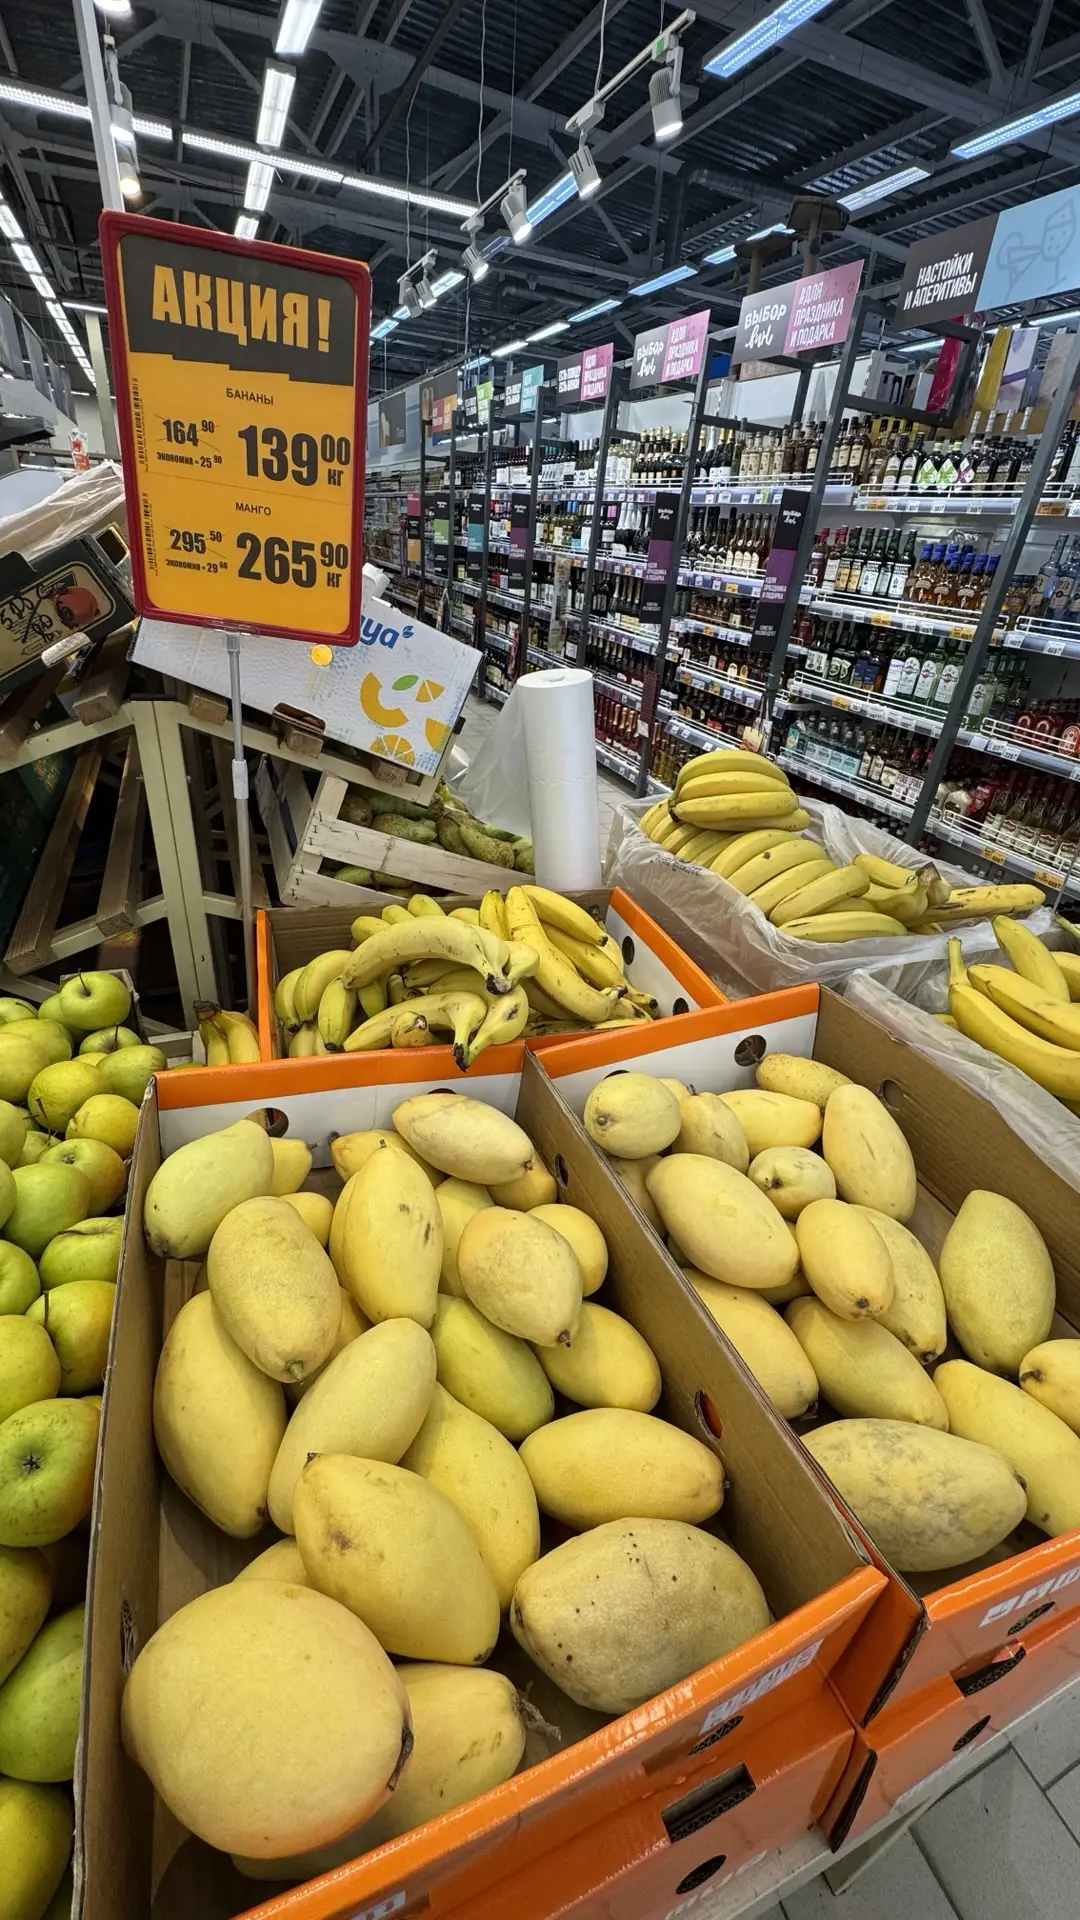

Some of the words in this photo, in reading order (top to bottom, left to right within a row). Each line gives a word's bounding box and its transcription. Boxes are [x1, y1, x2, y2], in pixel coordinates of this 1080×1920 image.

[916, 252, 974, 287] НАСТОЙКИ
[798, 282, 824, 306] #ДЛЯ
[903, 290, 913, 310] И
[911, 272, 978, 308] АПЕРИТИВЫ
[152, 264, 331, 353] АКЦИЯ!
[744, 303, 787, 330] ВЫБОР
[793, 297, 845, 327] ПРАЗДНИКА
[789, 331, 797, 348] И
[796, 321, 836, 347] ПОДАРКА
[226, 387, 274, 405] БАНАНЫ
[162, 419, 199, 447] 164
[201, 419, 215, 434] 90
[156, 452, 194, 466] ЭКОНОМИЯ
[200, 456, 212, 469] 25
[238, 425, 319, 486] 139
[320, 433, 351, 466] 00
[235, 502, 272, 516] МАНГО
[169, 528, 207, 554] 295
[209, 530, 222, 543] 50
[207, 562, 218, 574] 29
[236, 532, 317, 589] 265
[320, 541, 349, 570] 90
